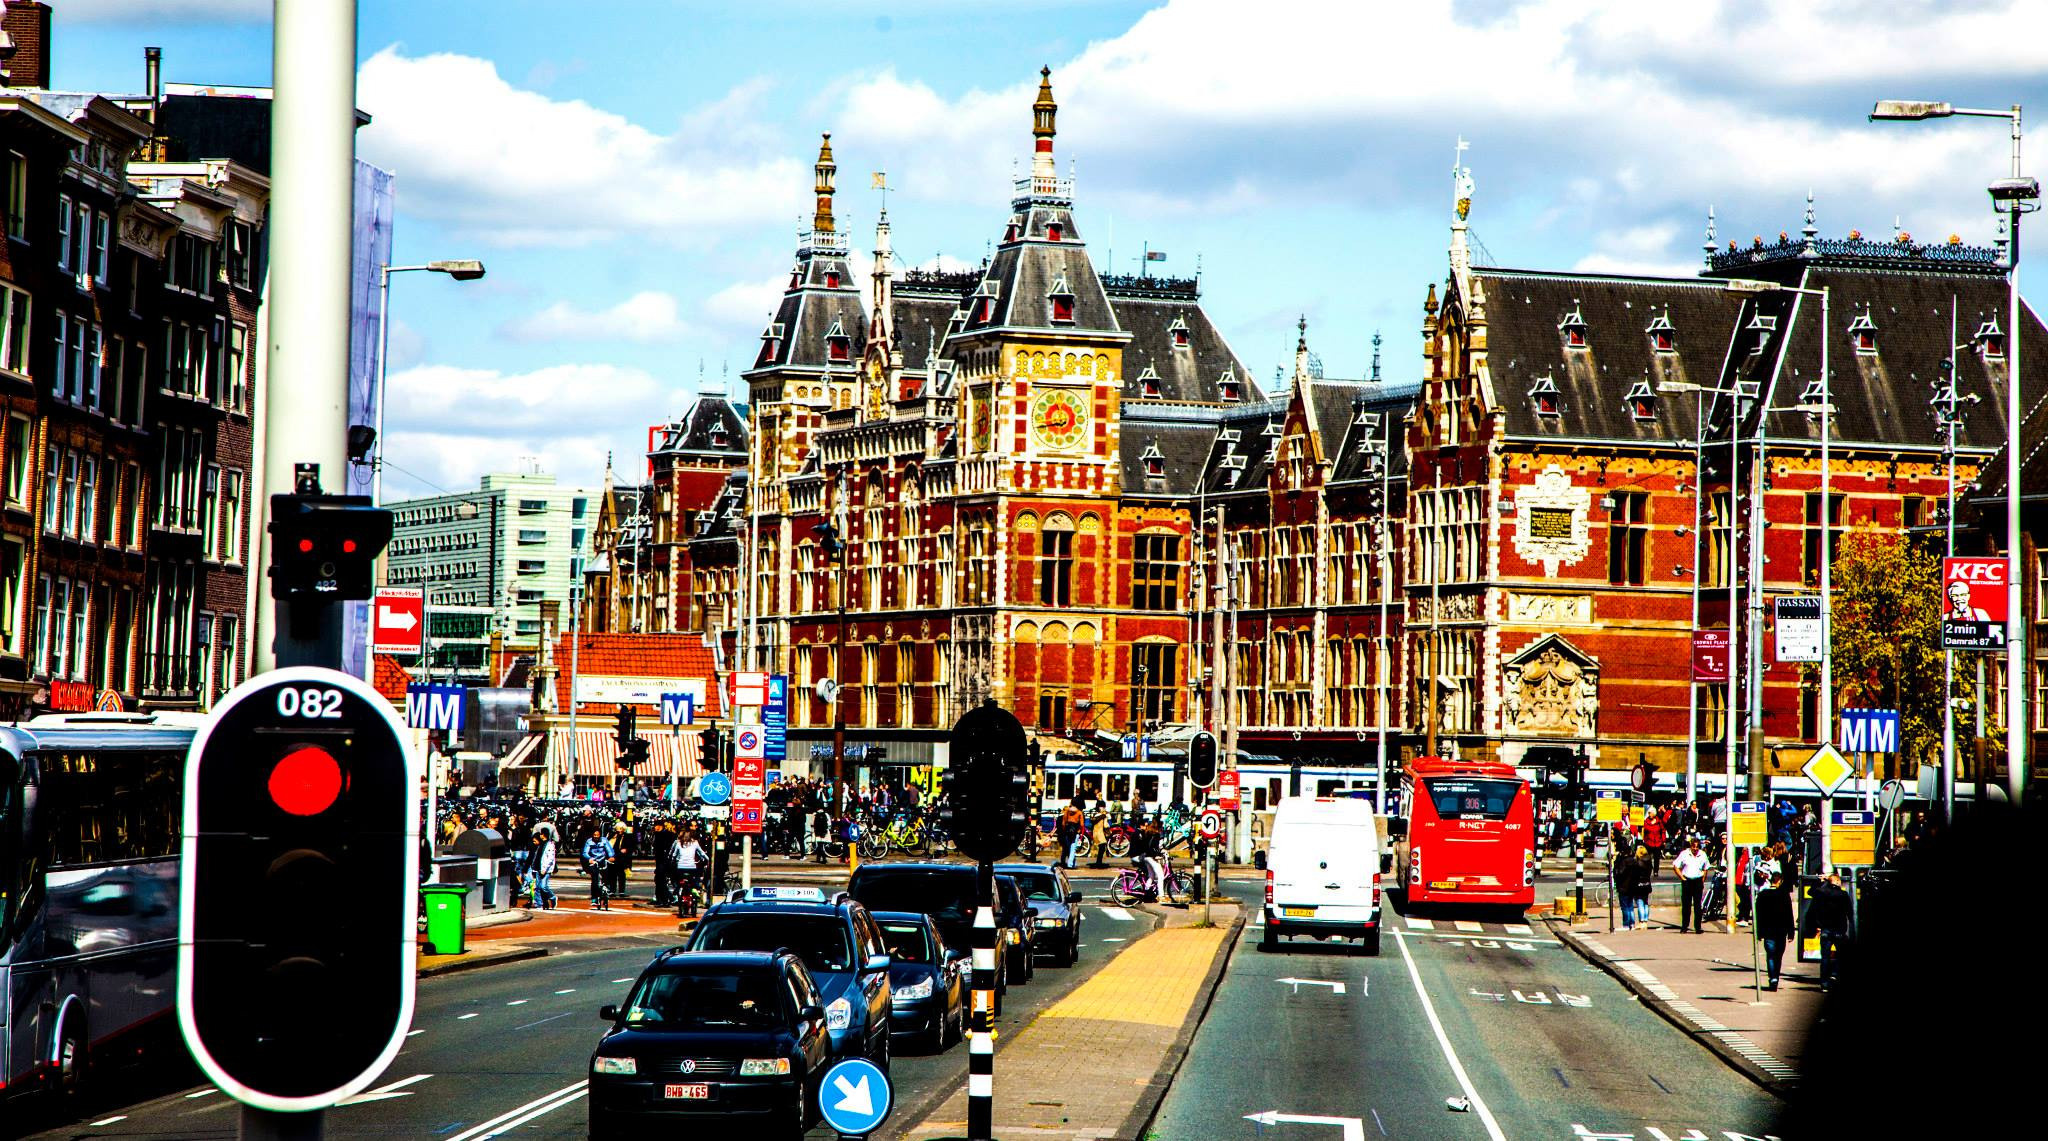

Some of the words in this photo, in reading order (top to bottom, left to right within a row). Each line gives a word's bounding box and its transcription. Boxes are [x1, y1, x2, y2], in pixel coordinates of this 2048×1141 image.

[1948, 563, 2004, 580] KFC
[1778, 598, 1820, 608] GASSAN
[1945, 623, 1953, 634] 2
[1954, 624, 1977, 635] min
[1945, 637, 1978, 645] Damrak
[1979, 638, 1990, 646] 87
[277, 687, 343, 719] 082
[429, 694, 460, 730] M
[663, 700, 690, 725] M
[1841, 718, 1867, 752] M
[1870, 719, 1895, 753] M
[1122, 741, 1135, 758] M
[1465, 797, 1480, 810] 306
